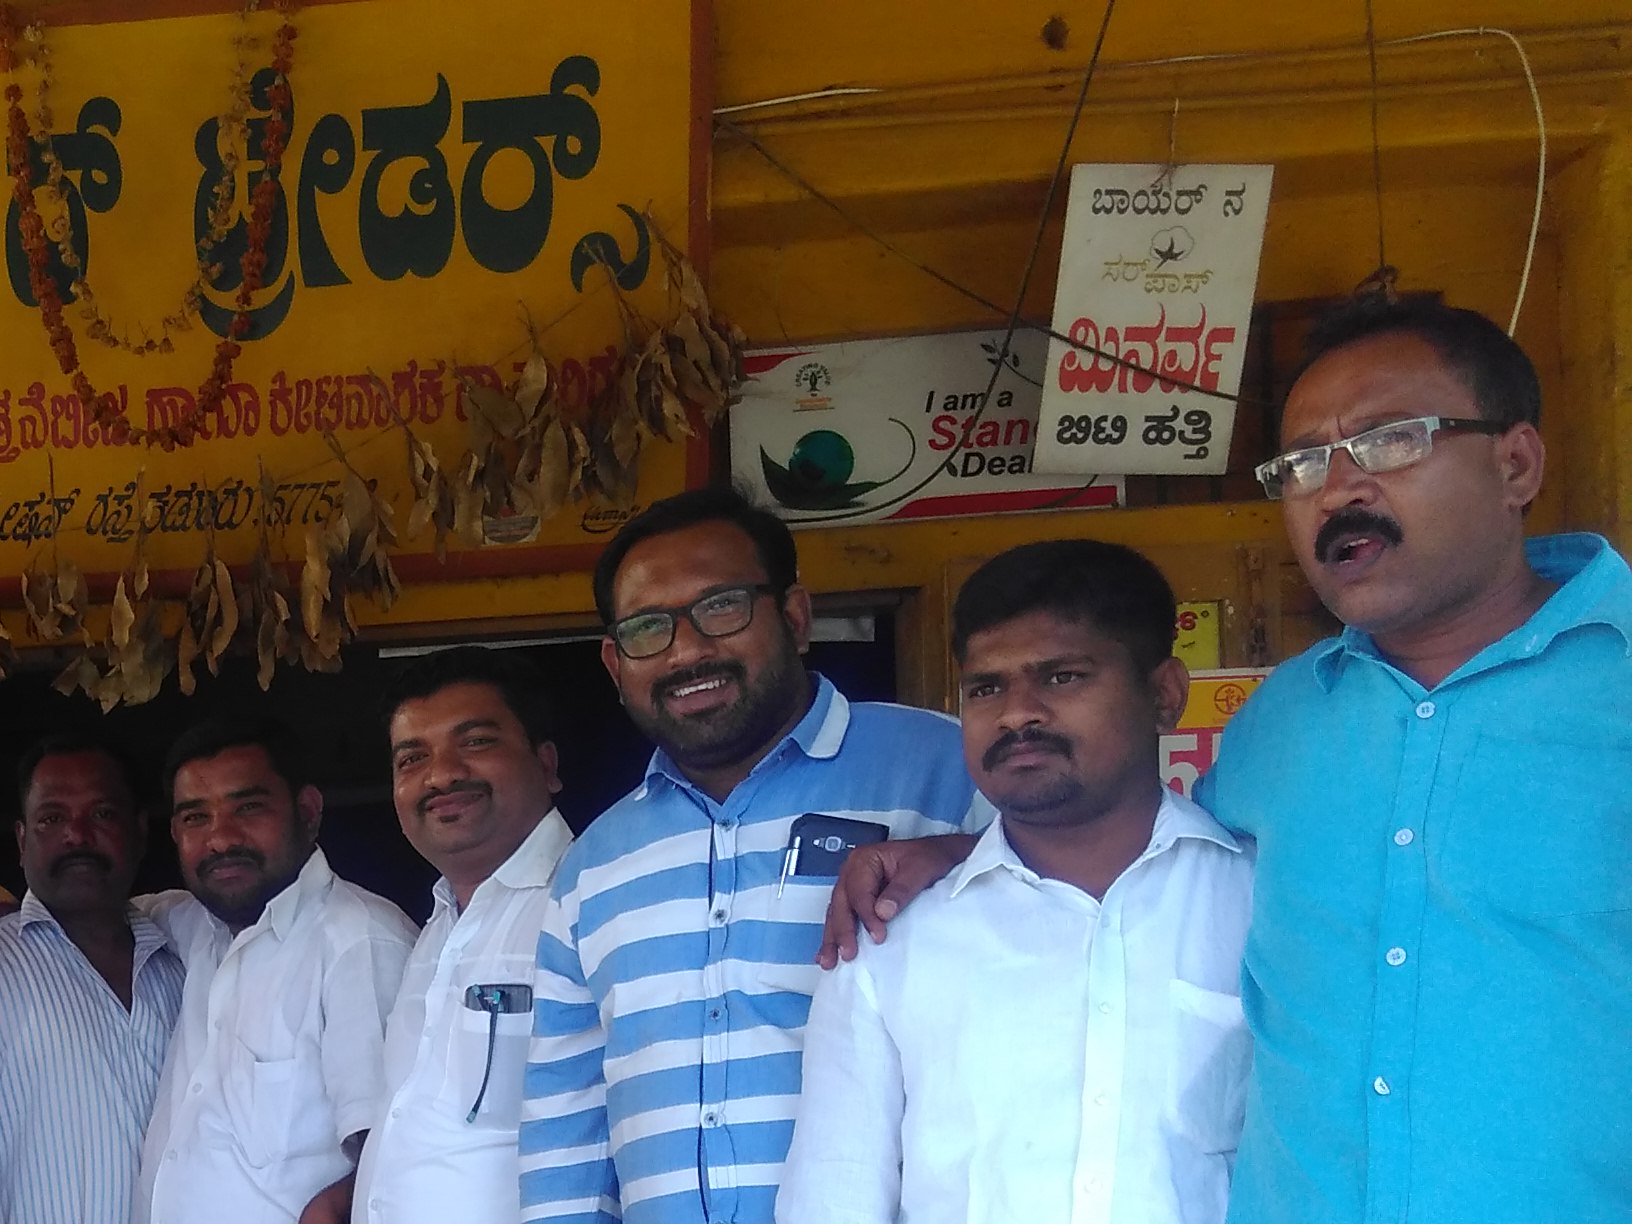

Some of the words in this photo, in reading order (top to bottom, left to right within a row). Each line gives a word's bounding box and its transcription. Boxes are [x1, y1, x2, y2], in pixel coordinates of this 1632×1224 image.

[1092, 183, 1208, 216] ಬಾಯರ್
[1222, 182, 1246, 217] ನ
[925, 390, 936, 413] I
[943, 391, 986, 412] am
[997, 390, 1014, 408] a
[928, 414, 1039, 451] Stan
[1056, 413, 1128, 446] ಬಿಟಿ
[1141, 404, 1213, 461] ಹತ್ತಿ
